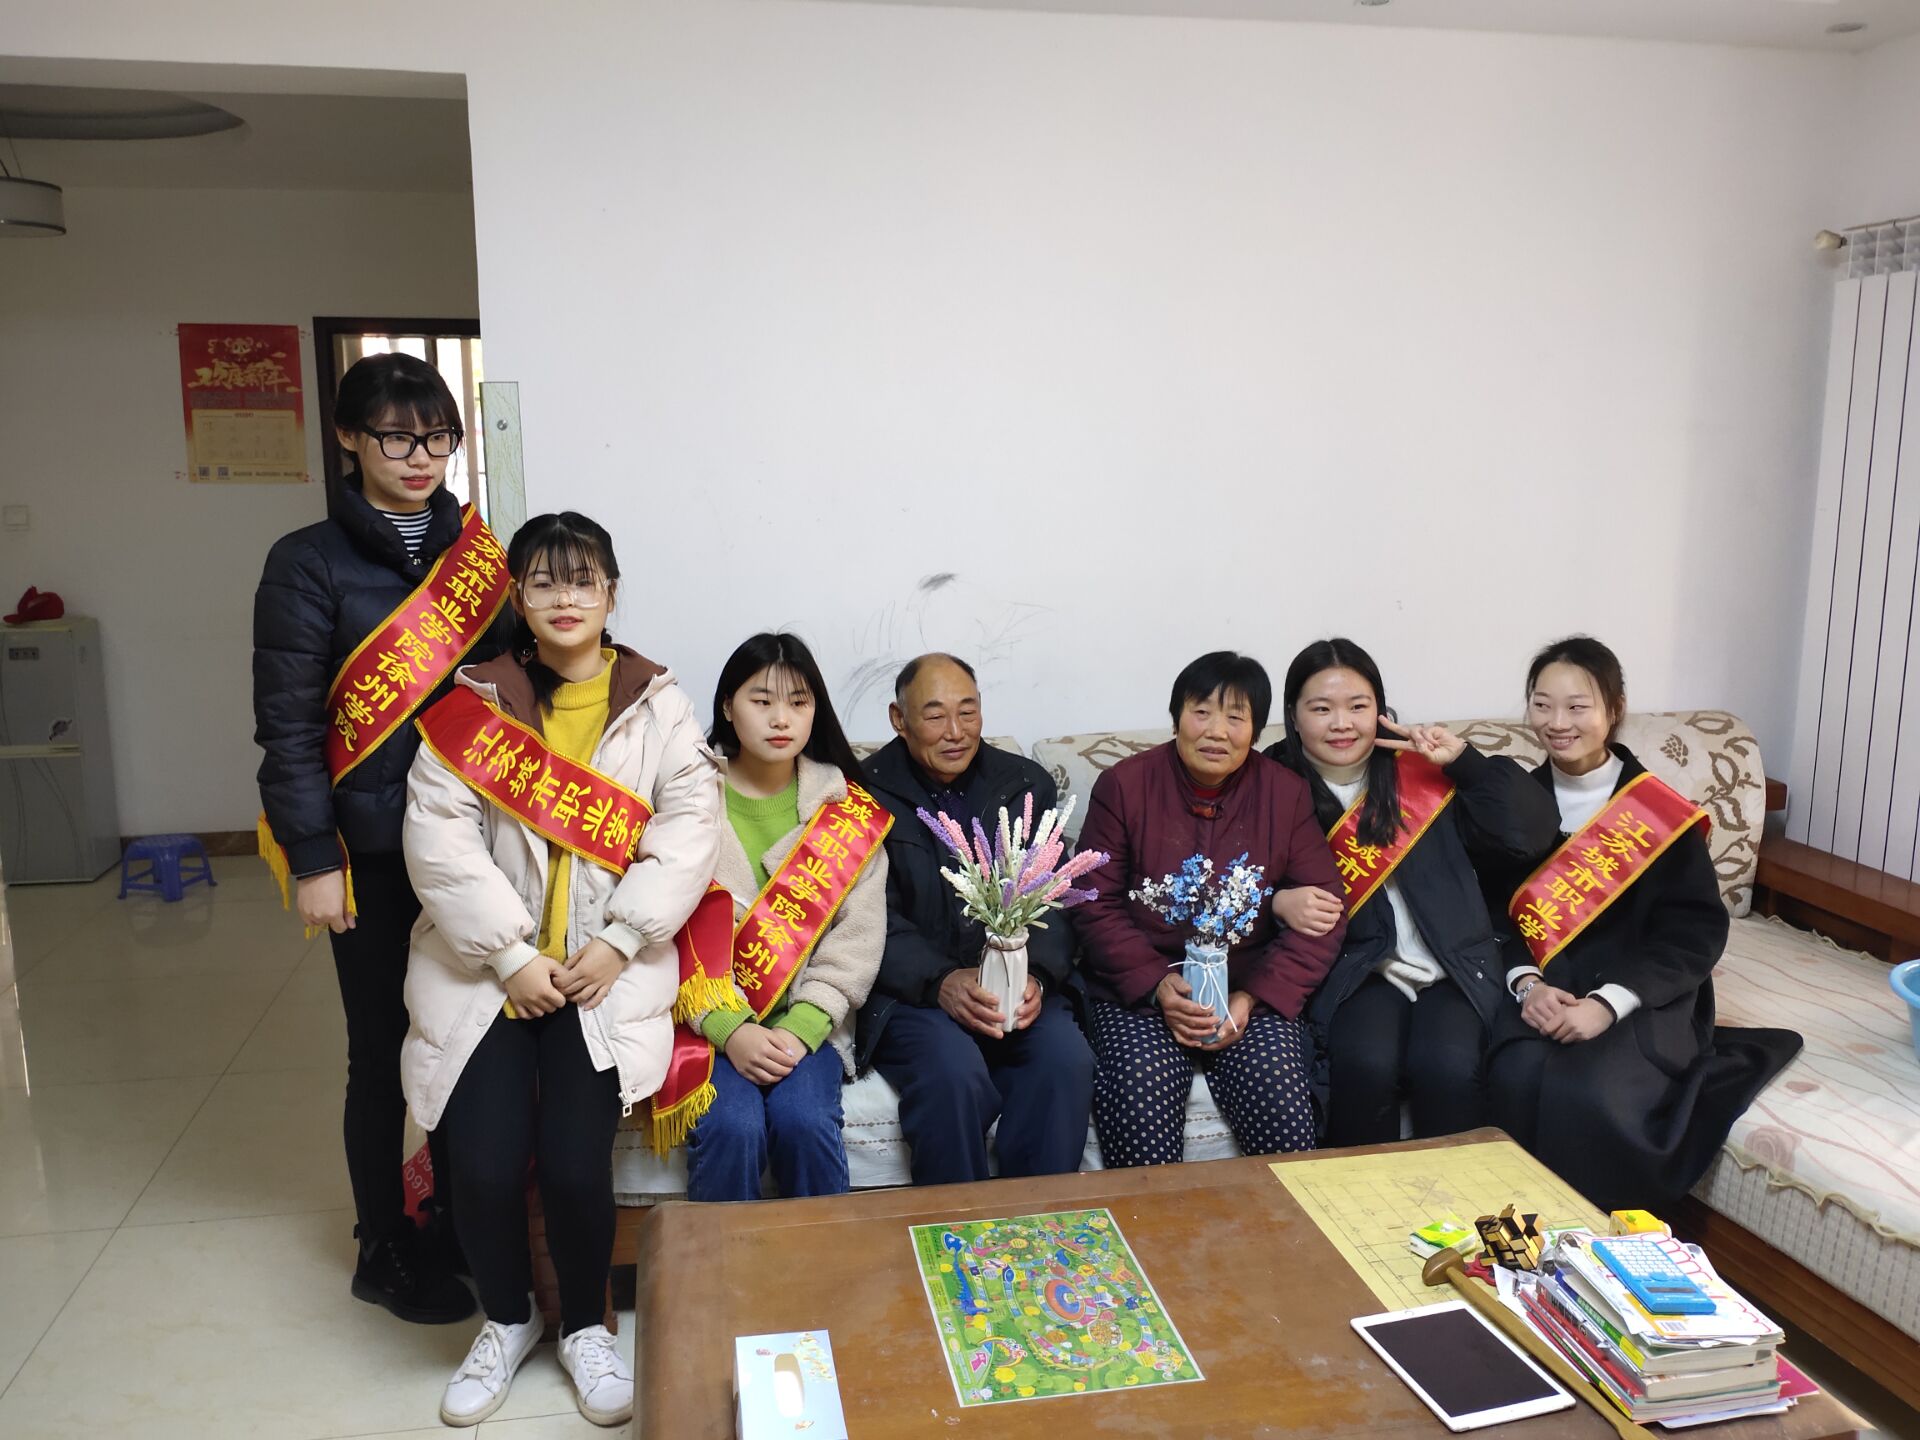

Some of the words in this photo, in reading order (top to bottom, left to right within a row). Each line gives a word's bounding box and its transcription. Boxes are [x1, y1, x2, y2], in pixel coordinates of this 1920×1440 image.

[335, 521, 507, 751] 苏城市职业学院徐州学院
[1518, 811, 1655, 954] 江苏城市职业学
